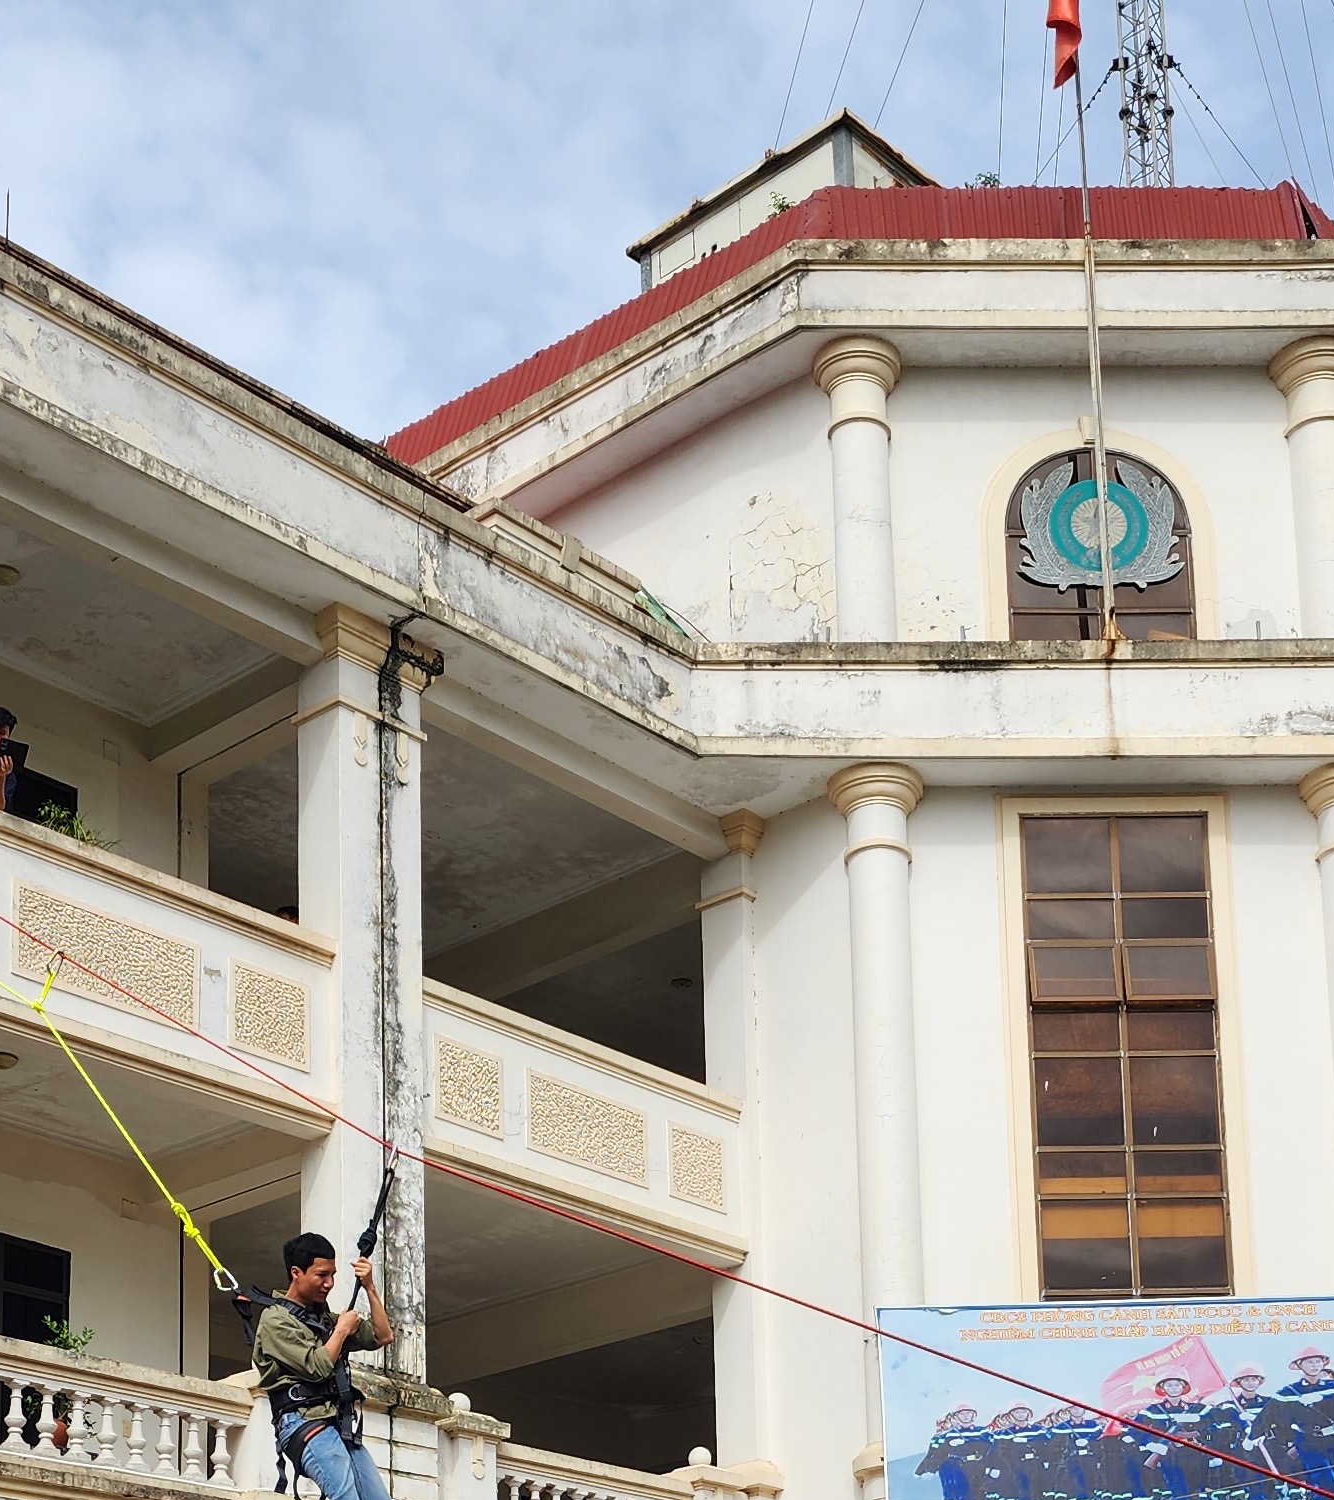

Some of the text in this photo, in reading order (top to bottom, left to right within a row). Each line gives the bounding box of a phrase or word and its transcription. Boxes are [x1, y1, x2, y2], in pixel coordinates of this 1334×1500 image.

[1031, 1308, 1094, 1322] PHÒNG
[1156, 1305, 1190, 1319] SÁT
[1194, 1306, 1242, 1318] PCCC
[1246, 1306, 1261, 1317] &
[1264, 1304, 1317, 1317] CNCH
[1101, 1322, 1148, 1338] CHẤP
[1152, 1321, 1206, 1336] HÀNH
